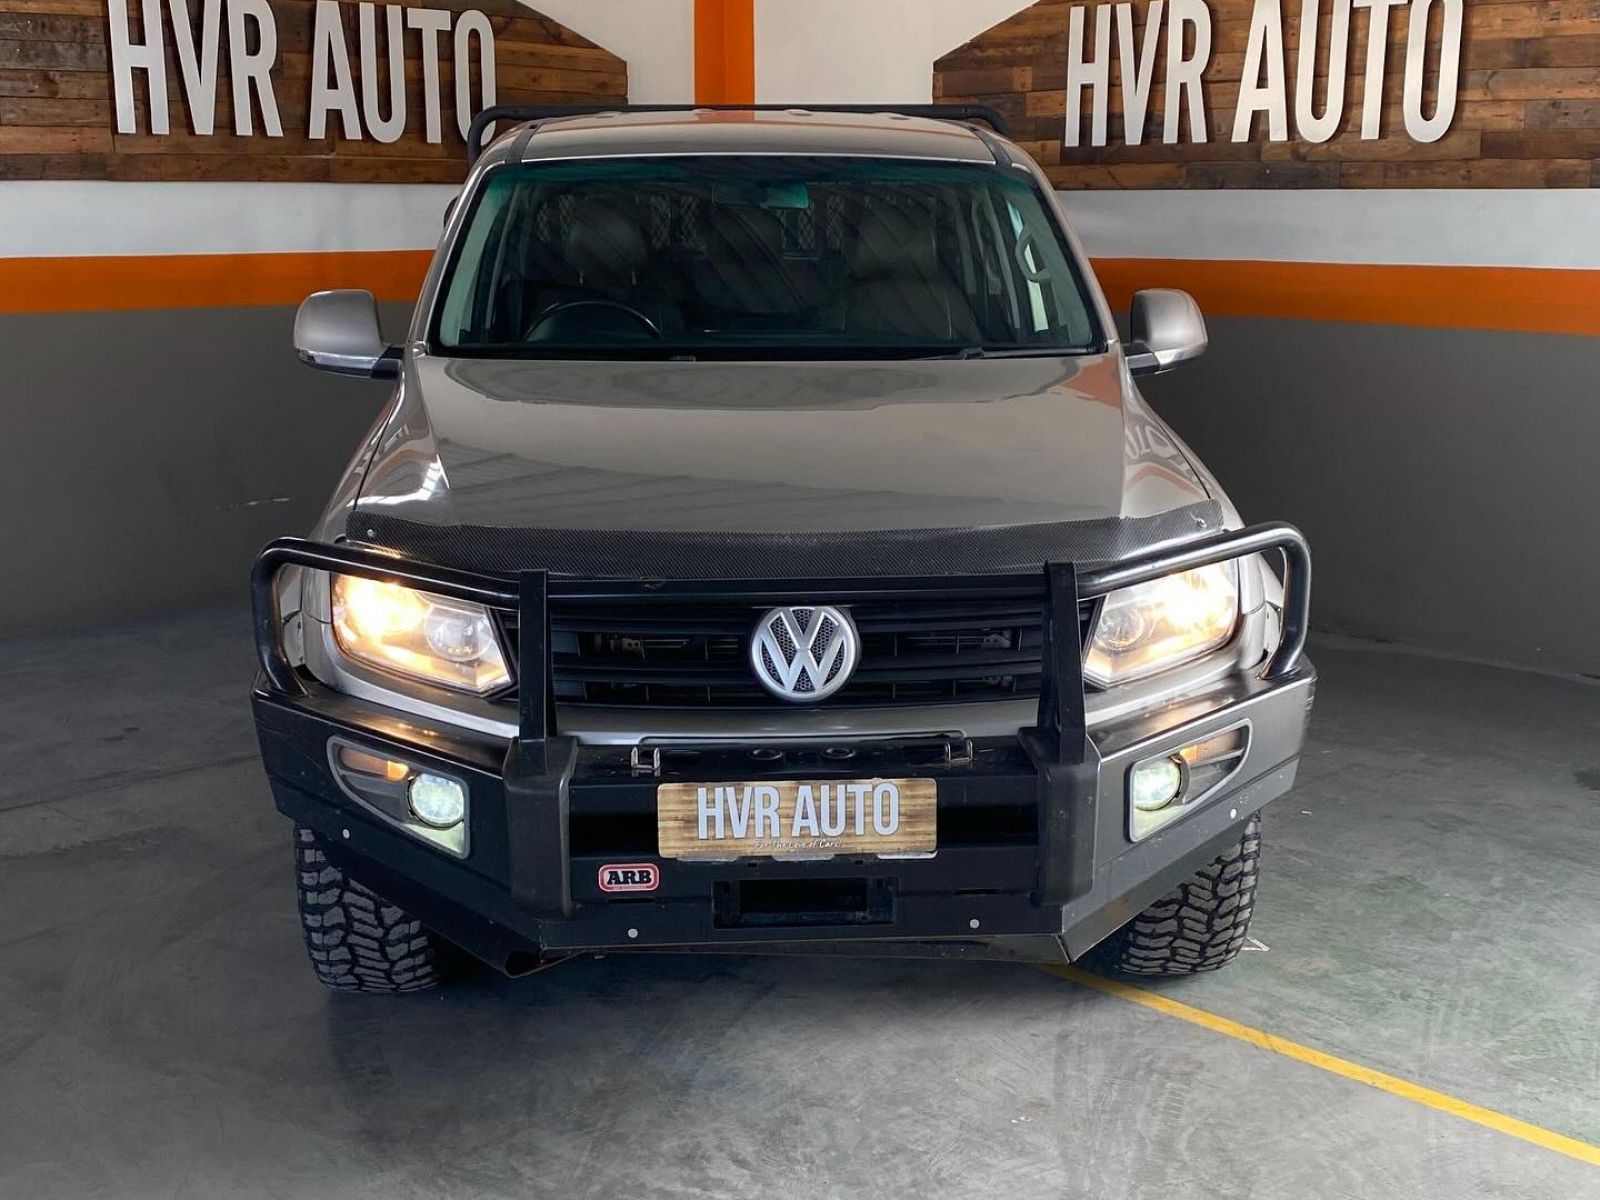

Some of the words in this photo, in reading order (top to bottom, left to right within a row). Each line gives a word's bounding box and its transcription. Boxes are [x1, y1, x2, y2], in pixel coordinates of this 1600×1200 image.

[107, 0, 284, 137] HVR
[308, 0, 496, 147] AUTO
[1064, 0, 1212, 147] HVR
[1231, 0, 1463, 144] AUTO
[698, 785, 780, 839] HVR
[791, 783, 900, 837] AUTO
[606, 869, 652, 885] ARB
